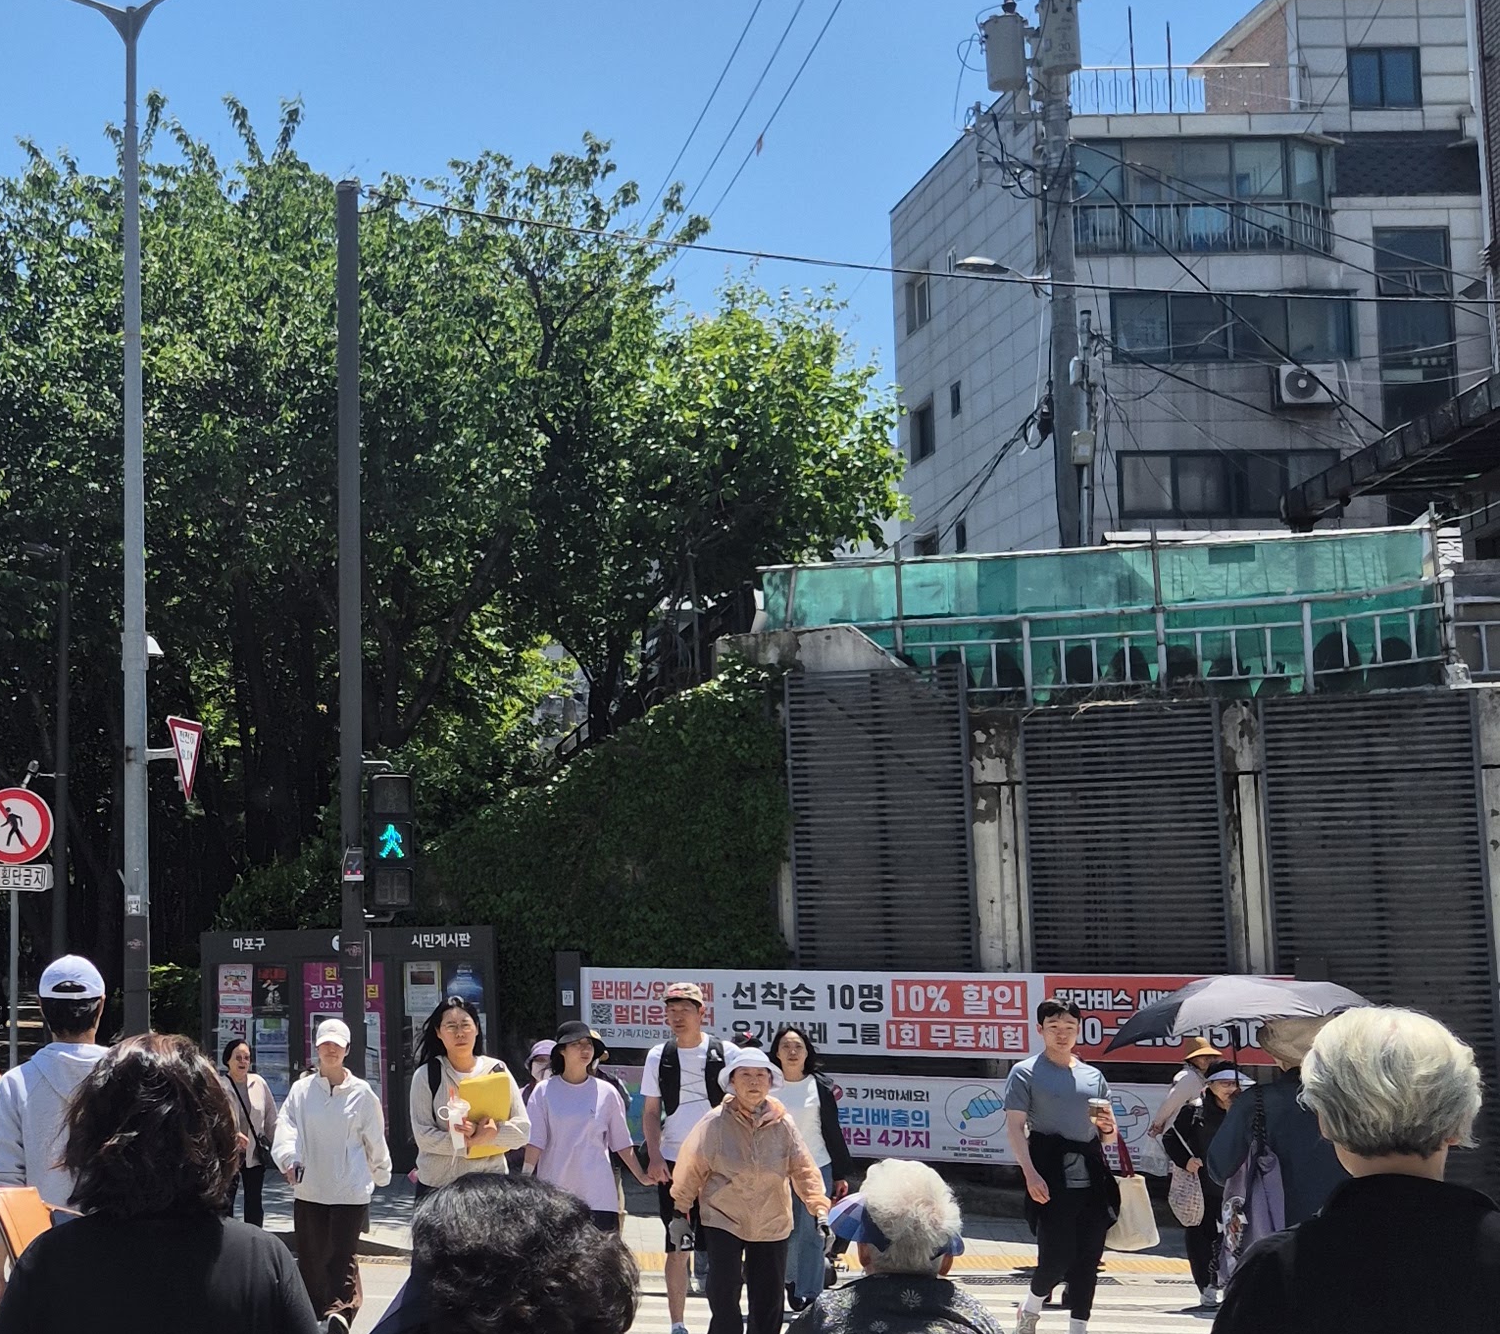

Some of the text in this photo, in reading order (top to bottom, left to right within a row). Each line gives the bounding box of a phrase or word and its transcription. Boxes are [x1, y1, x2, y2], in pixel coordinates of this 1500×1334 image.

[233, 937, 266, 952] 마포구
[411, 932, 471, 949] 시민게시판
[731, 981, 884, 1013] 선착순 10명
[895, 982, 1023, 1016] 10% 할인
[230, 1018, 246, 1040] 책
[837, 1022, 880, 1045] 그룹
[889, 1023, 1023, 1051] 1회 무료체험
[845, 1087, 930, 1102] 꼭 기억하세요!
[838, 1106, 930, 1128] 분리배출의
[877, 1129, 931, 1149] 4가지
